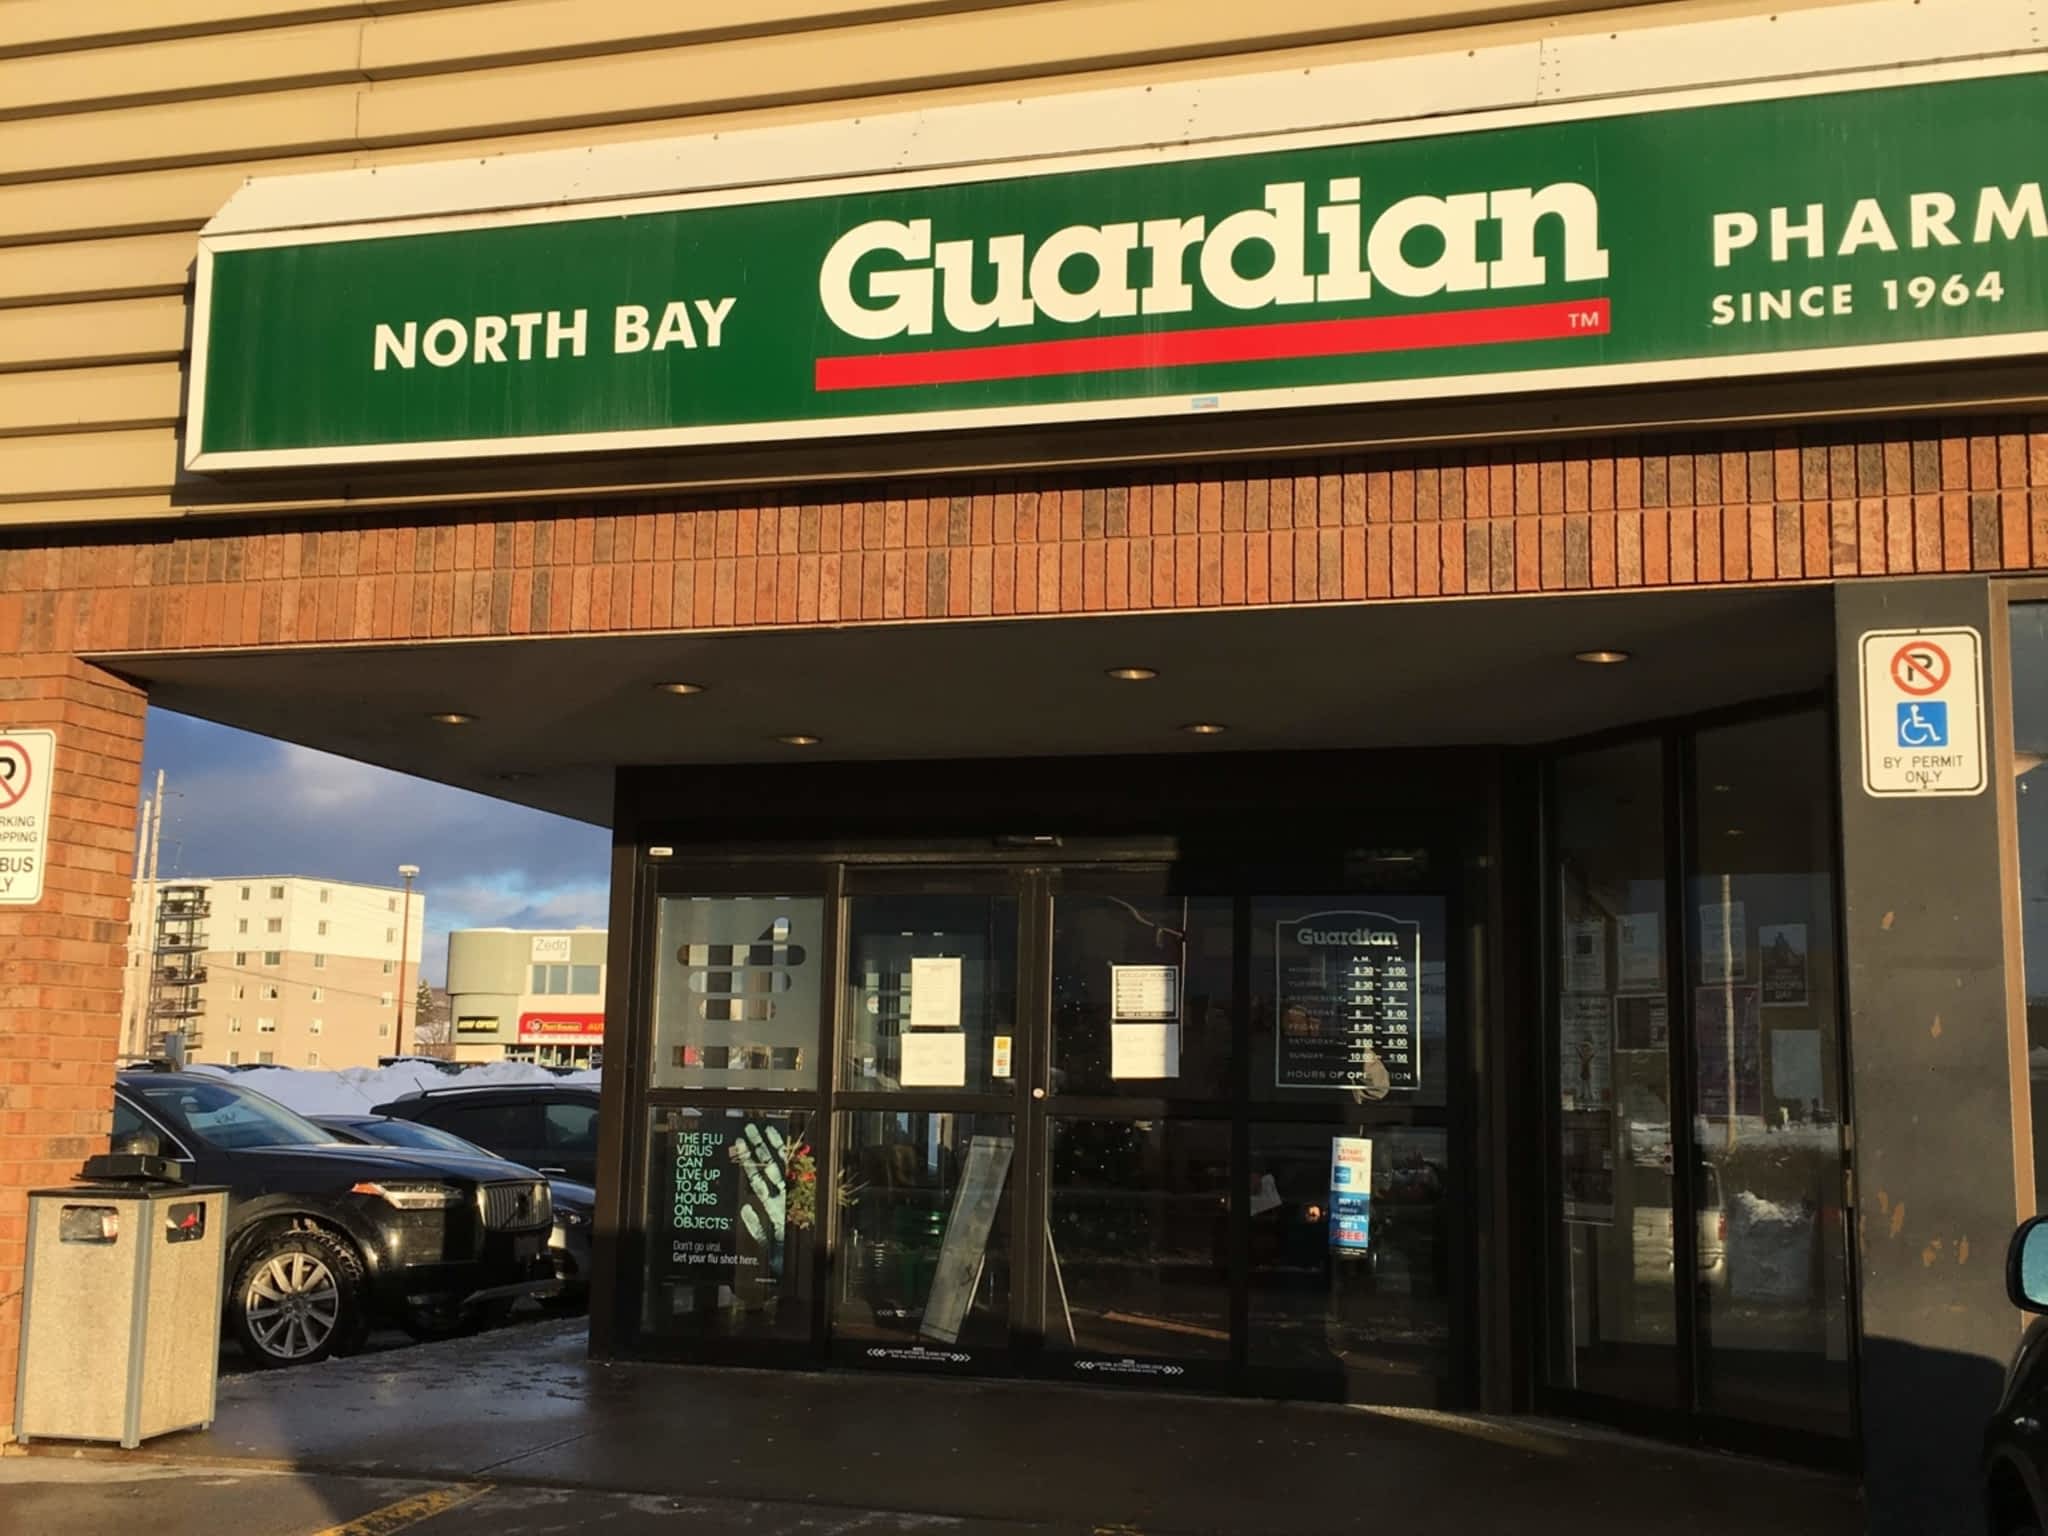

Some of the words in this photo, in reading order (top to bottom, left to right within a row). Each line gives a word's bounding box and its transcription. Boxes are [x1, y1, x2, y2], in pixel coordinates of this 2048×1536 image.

[1712, 182, 2048, 268] PHARM
[818, 176, 1609, 341] Guardian
[1711, 283, 1853, 326] SINCE
[1882, 270, 2005, 310] 1964
[1568, 310, 1600, 328] TM
[373, 309, 588, 371] NORTH
[613, 297, 738, 354] BAY
[1883, 755, 1903, 769] BY
[1911, 754, 1964, 768] PERMIT
[1904, 769, 1943, 783] ONLY
[0, 831, 38, 843] PPING
[1297, 928, 1399, 946] Guardian
[535, 938, 568, 952] Zedd
[1287, 1070, 1326, 1080] HOURS
[1328, 1071, 1345, 1080] OF
[677, 1132, 700, 1145] THE
[702, 1133, 724, 1145] FLU
[676, 1145, 713, 1157] VIRUS
[676, 1156, 704, 1169] CAN
[675, 1168, 701, 1181] LIVE
[703, 1169, 721, 1181] UP
[675, 1180, 692, 1192] TO
[693, 1181, 709, 1192] 48
[674, 1192, 718, 1205] HOURS
[674, 1204, 693, 1216] ON
[694, 1242, 705, 1253] go
[672, 1252, 687, 1263] Get
[688, 1254, 706, 1265] your
[707, 1253, 718, 1264] flu
[719, 1254, 738, 1265] shot
